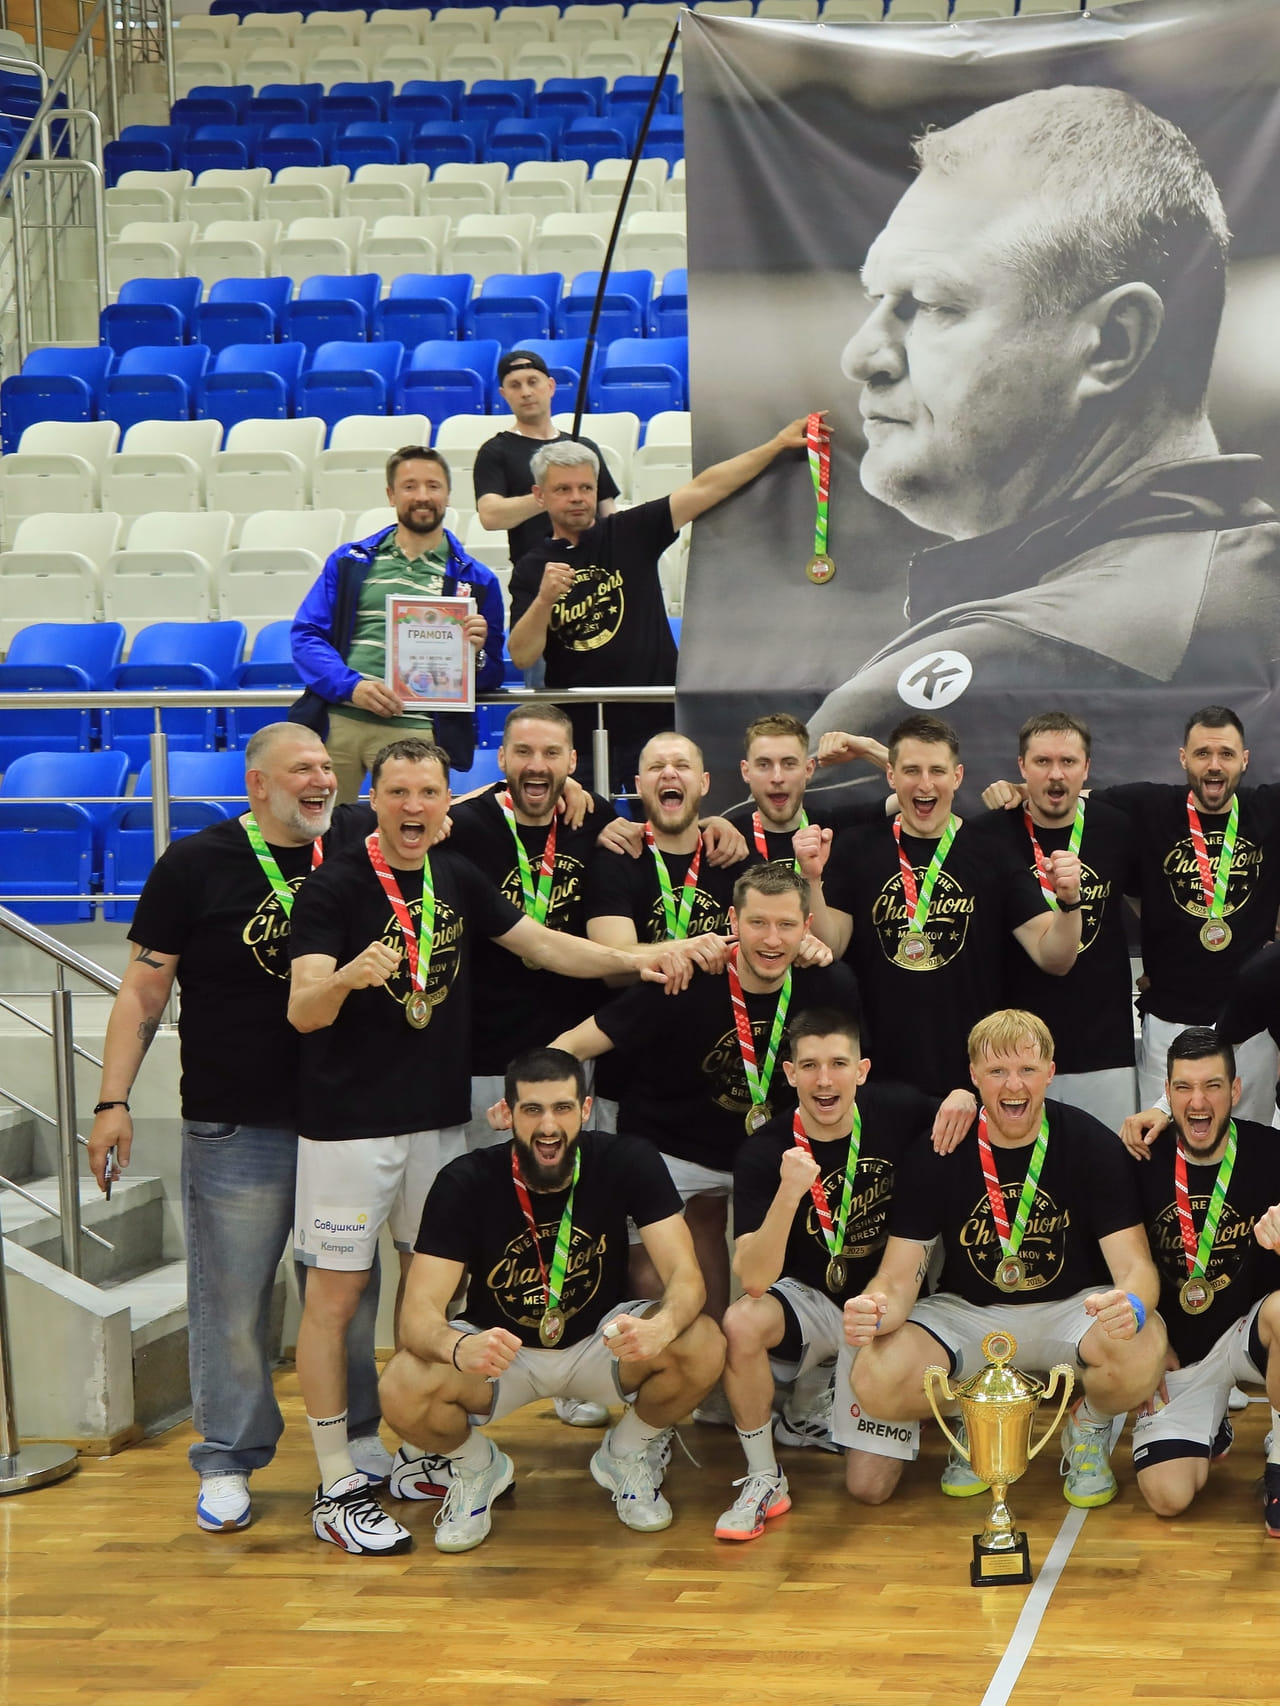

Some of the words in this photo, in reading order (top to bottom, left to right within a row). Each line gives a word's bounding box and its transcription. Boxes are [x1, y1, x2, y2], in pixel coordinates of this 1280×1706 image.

[408, 629, 454, 640] ГРАМОТА
[861, 1162, 884, 1175] THE
[314, 1218, 366, 1233] Савушкин
[850, 1225, 882, 1243] BREST
[321, 1240, 355, 1254] Kempa
[511, 1237, 533, 1255] WE
